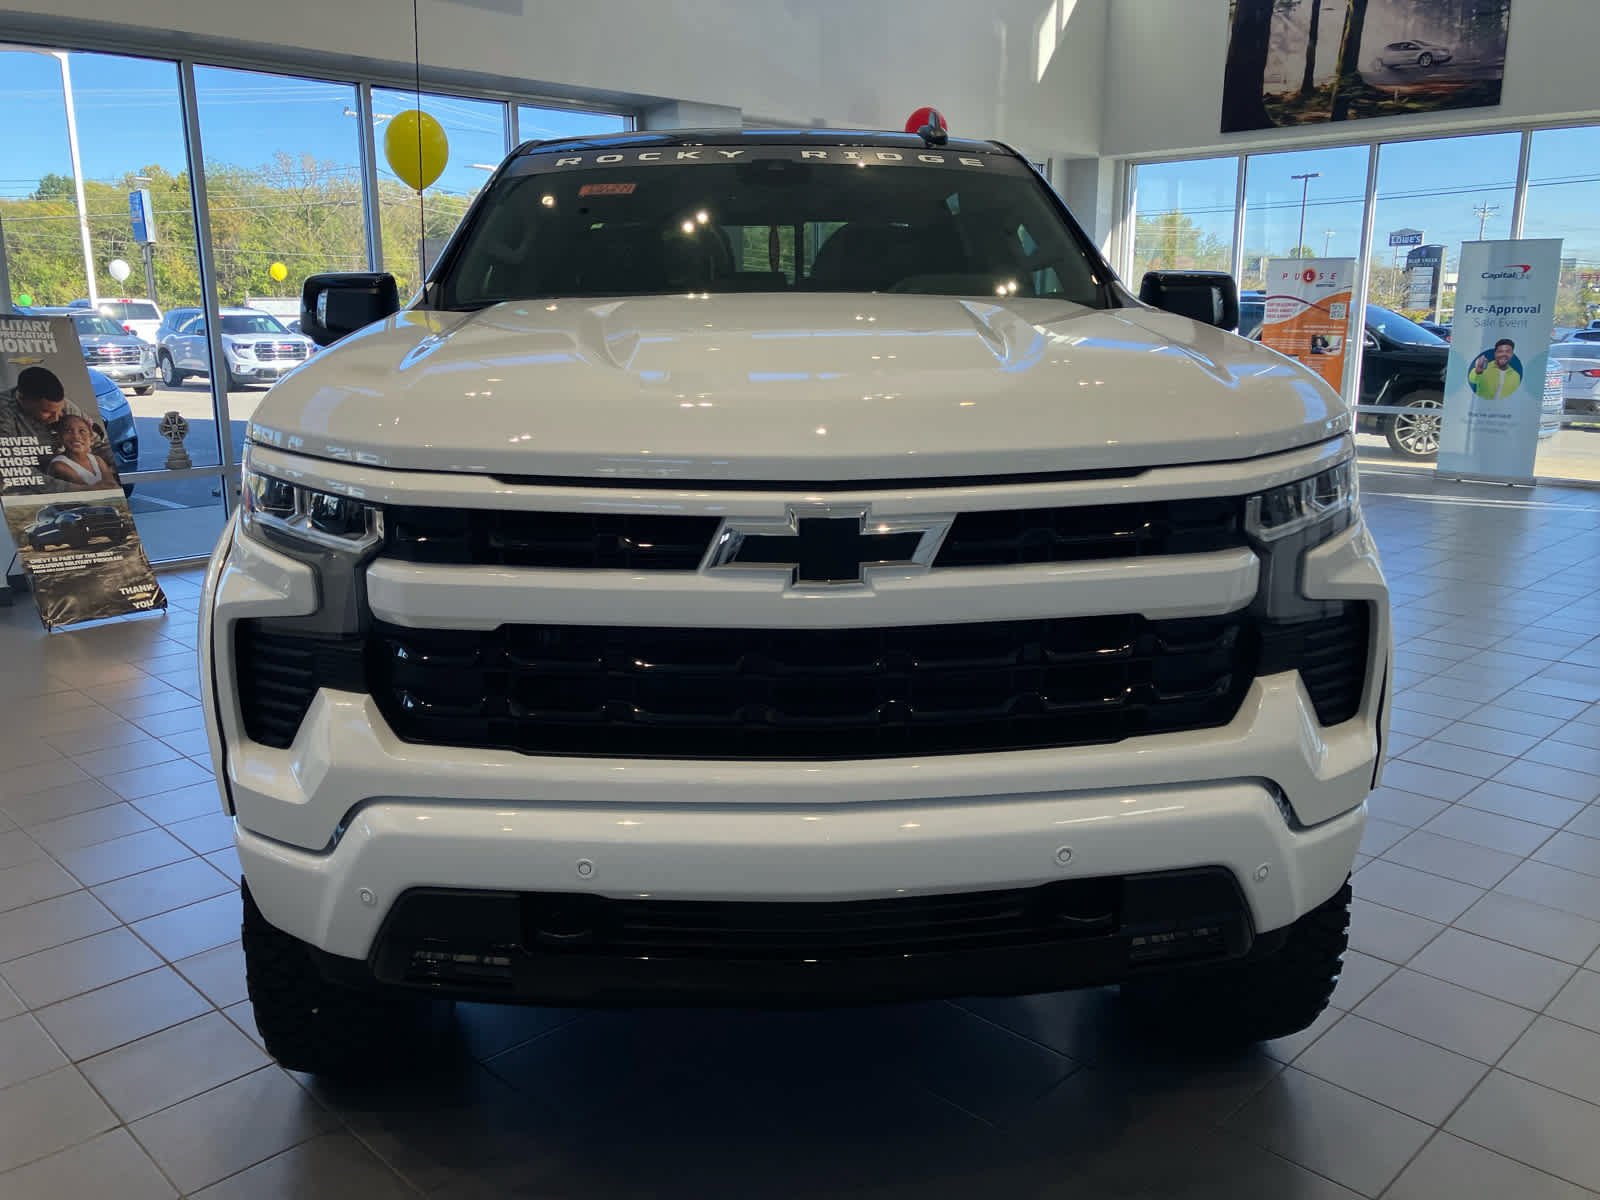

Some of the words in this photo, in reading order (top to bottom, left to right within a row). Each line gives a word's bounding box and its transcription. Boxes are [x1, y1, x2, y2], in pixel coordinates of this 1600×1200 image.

[555, 150, 745, 166] ROCKY
[801, 150, 985, 167] RIDGE
[1281, 271, 1337, 281] PULSE
[1481, 272, 1516, 280] Capital
[1465, 304, 1541, 316] Pre-Approval
[0, 320, 51, 331] LITARY
[0, 436, 39, 447] RIVEN
[12, 445, 54, 457] SERVE
[0, 456, 40, 467] THOSE
[0, 467, 32, 477] WHO
[3, 476, 45, 487] SERVE
[120, 583, 155, 595] THANK
[132, 599, 154, 609] YOU
